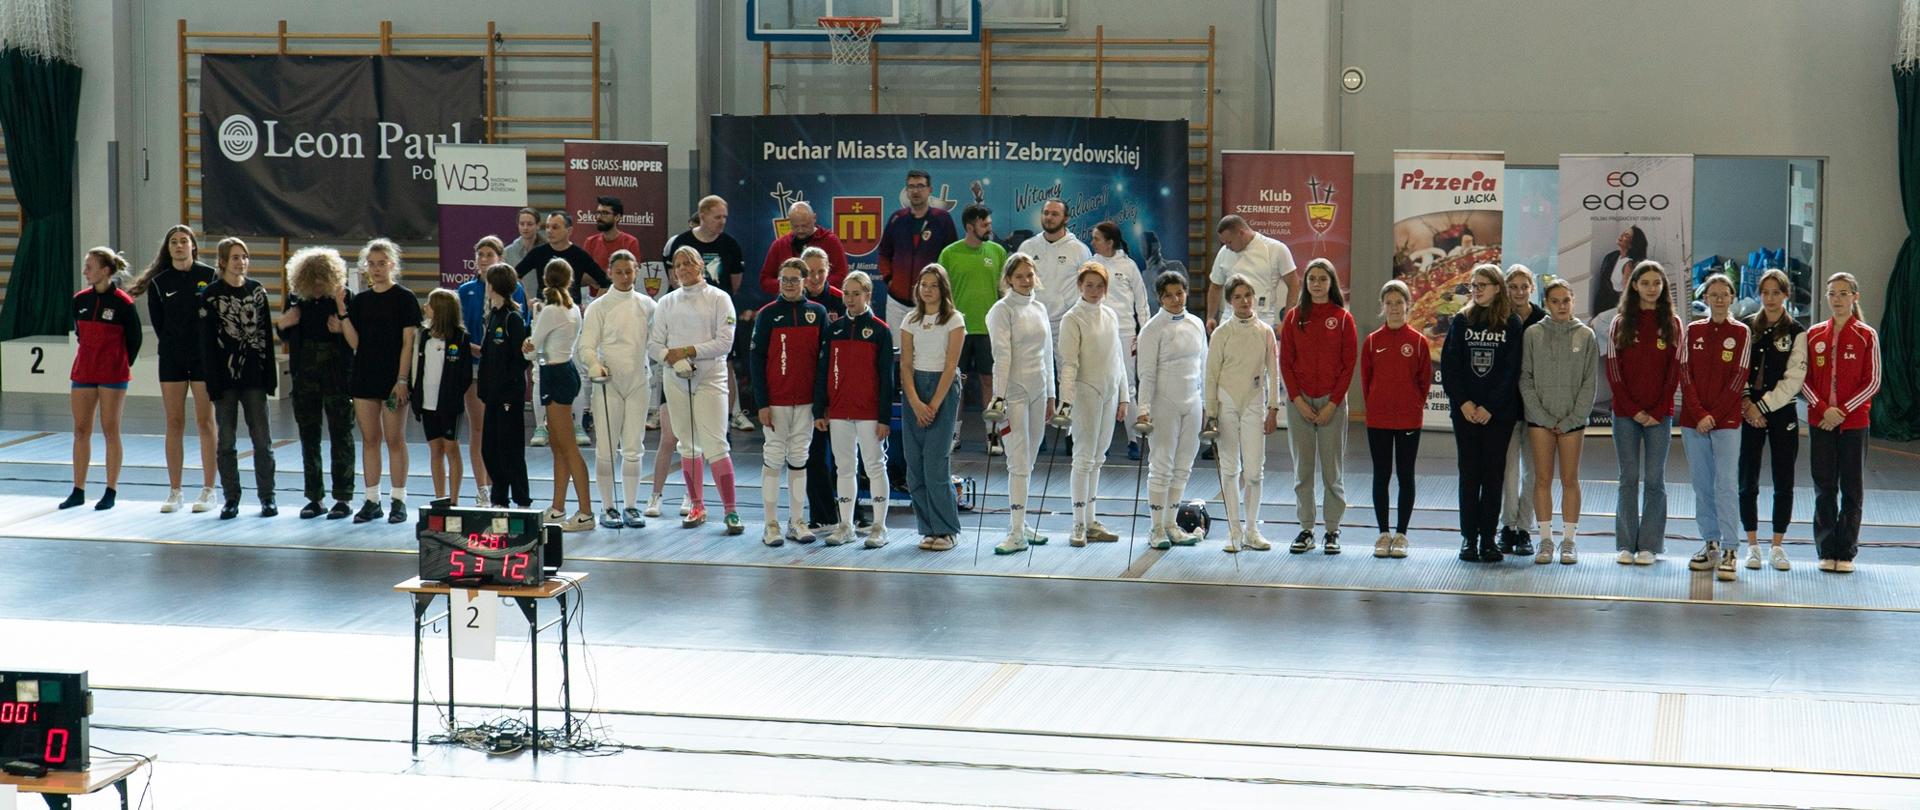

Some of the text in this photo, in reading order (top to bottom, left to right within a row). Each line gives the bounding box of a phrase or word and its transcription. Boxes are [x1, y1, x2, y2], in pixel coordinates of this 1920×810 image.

[263, 120, 365, 158] Leon
[570, 158, 663, 172] SKS GRASS-HOPPER
[763, 140, 1140, 170] Puchar Miasta Kalwarii Zebrzydowskiej
[412, 165, 437, 180] Pol
[441, 163, 489, 191] WGB
[595, 175, 639, 187] KALWARIA
[1400, 169, 1497, 191] Pizzeria
[1015, 182, 1062, 213] Witamy
[1260, 189, 1292, 202] Klub
[1454, 193, 1497, 205] U JACKA
[1583, 189, 1669, 211] edeo
[1235, 205, 1292, 214] SZERMIERZY
[1464, 327, 1507, 343] Oxford
[30, 347, 45, 374] 2
[780, 333, 788, 376] PIAST
[449, 550, 466, 576] 5
[473, 556, 484, 573] 3
[502, 552, 531, 579] 12
[466, 606, 480, 629] 2
[44, 728, 69, 764] 0
